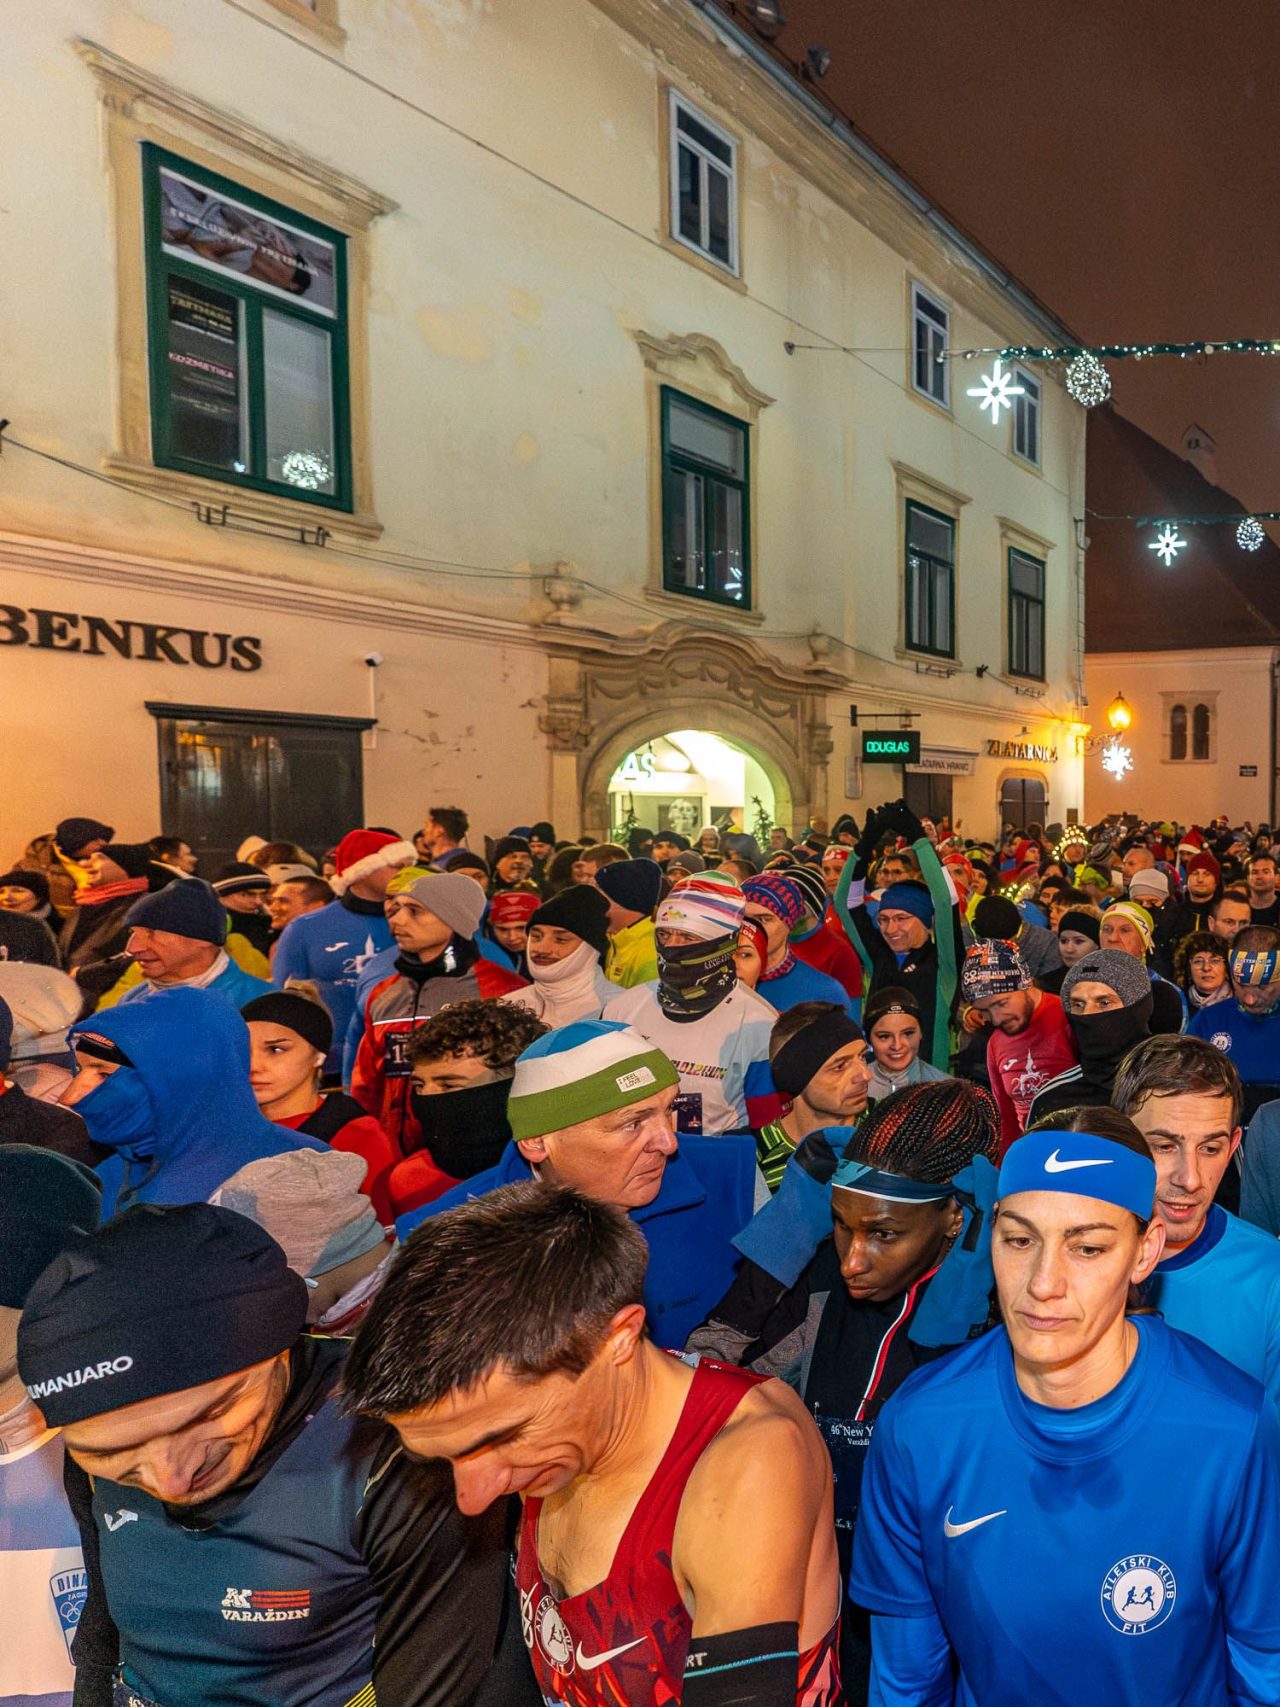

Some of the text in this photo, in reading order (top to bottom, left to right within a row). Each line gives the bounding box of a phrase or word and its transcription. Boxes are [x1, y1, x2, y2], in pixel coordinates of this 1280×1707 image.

[867, 741, 910, 753] DOUGLAS
[843, 1427, 864, 1437] New
[865, 1426, 874, 1437] Y
[1103, 1556, 1175, 1600] ATLETSKI KLUB
[221, 1608, 310, 1622] VARAŽDIN
[1122, 1622, 1147, 1634] FIT
